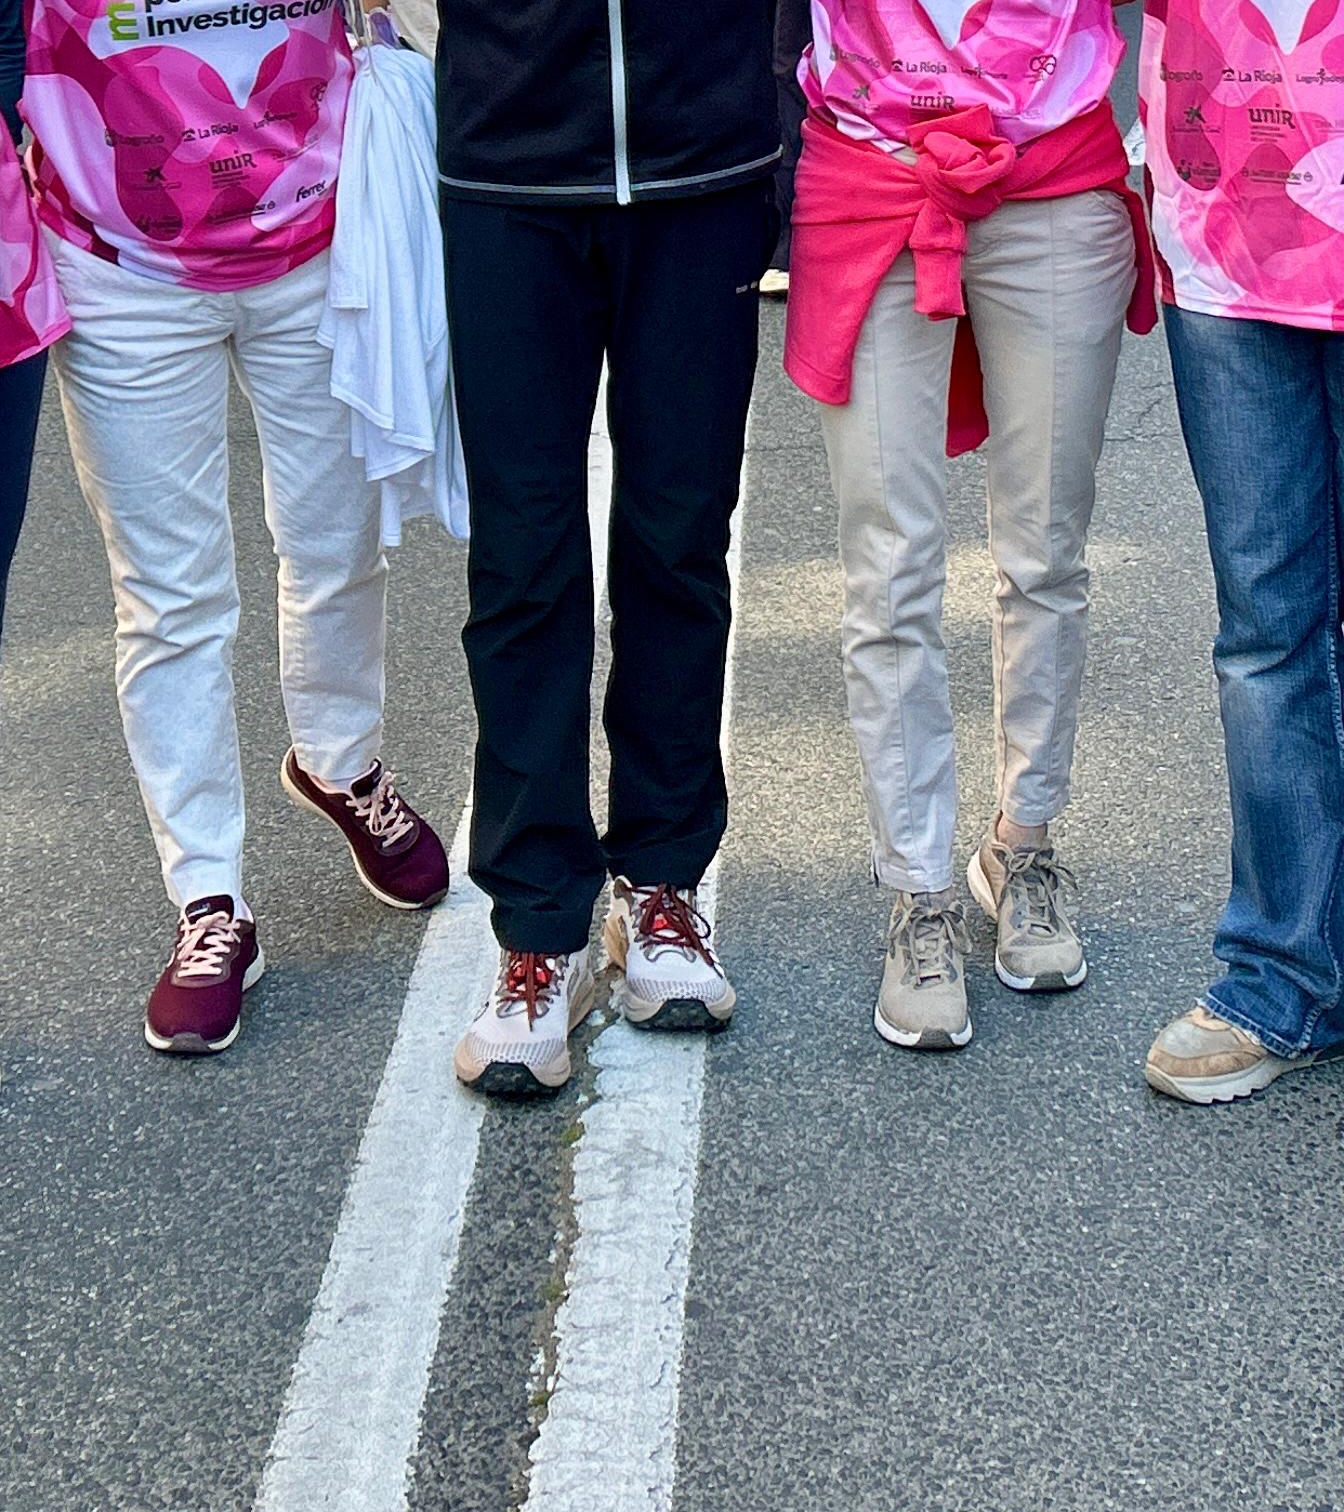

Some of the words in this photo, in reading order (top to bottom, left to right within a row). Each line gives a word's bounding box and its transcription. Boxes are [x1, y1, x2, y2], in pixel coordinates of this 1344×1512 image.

[905, 62, 918, 74] La
[919, 61, 948, 75] Rioja
[1238, 70, 1252, 83] La
[1253, 69, 1284, 84] Rioja
[197, 128, 211, 139] La
[211, 123, 240, 137] Rioja
